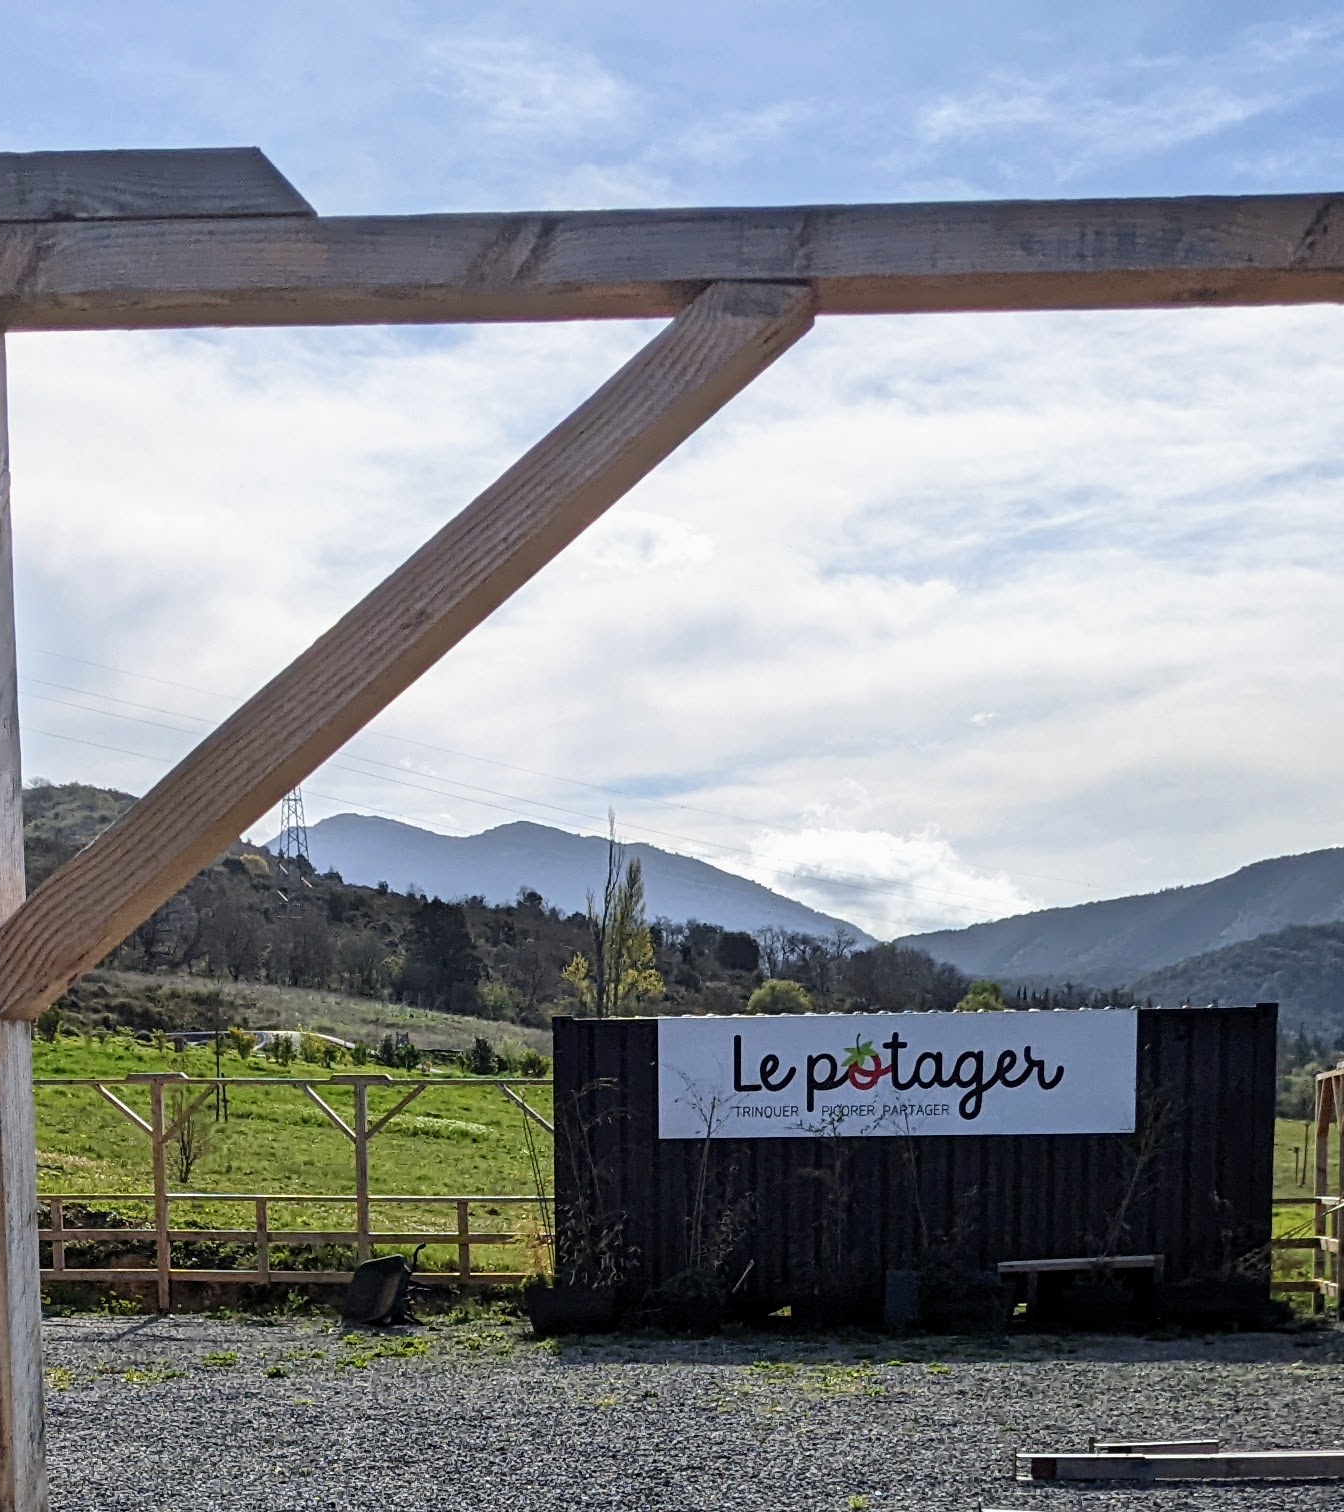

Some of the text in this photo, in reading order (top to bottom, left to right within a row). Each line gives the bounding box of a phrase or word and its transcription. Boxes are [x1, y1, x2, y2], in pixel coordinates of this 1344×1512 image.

[733, 1031, 1065, 1121] Le potager
[734, 1103, 951, 1119] TRINQUER PICORER PARTAGER
